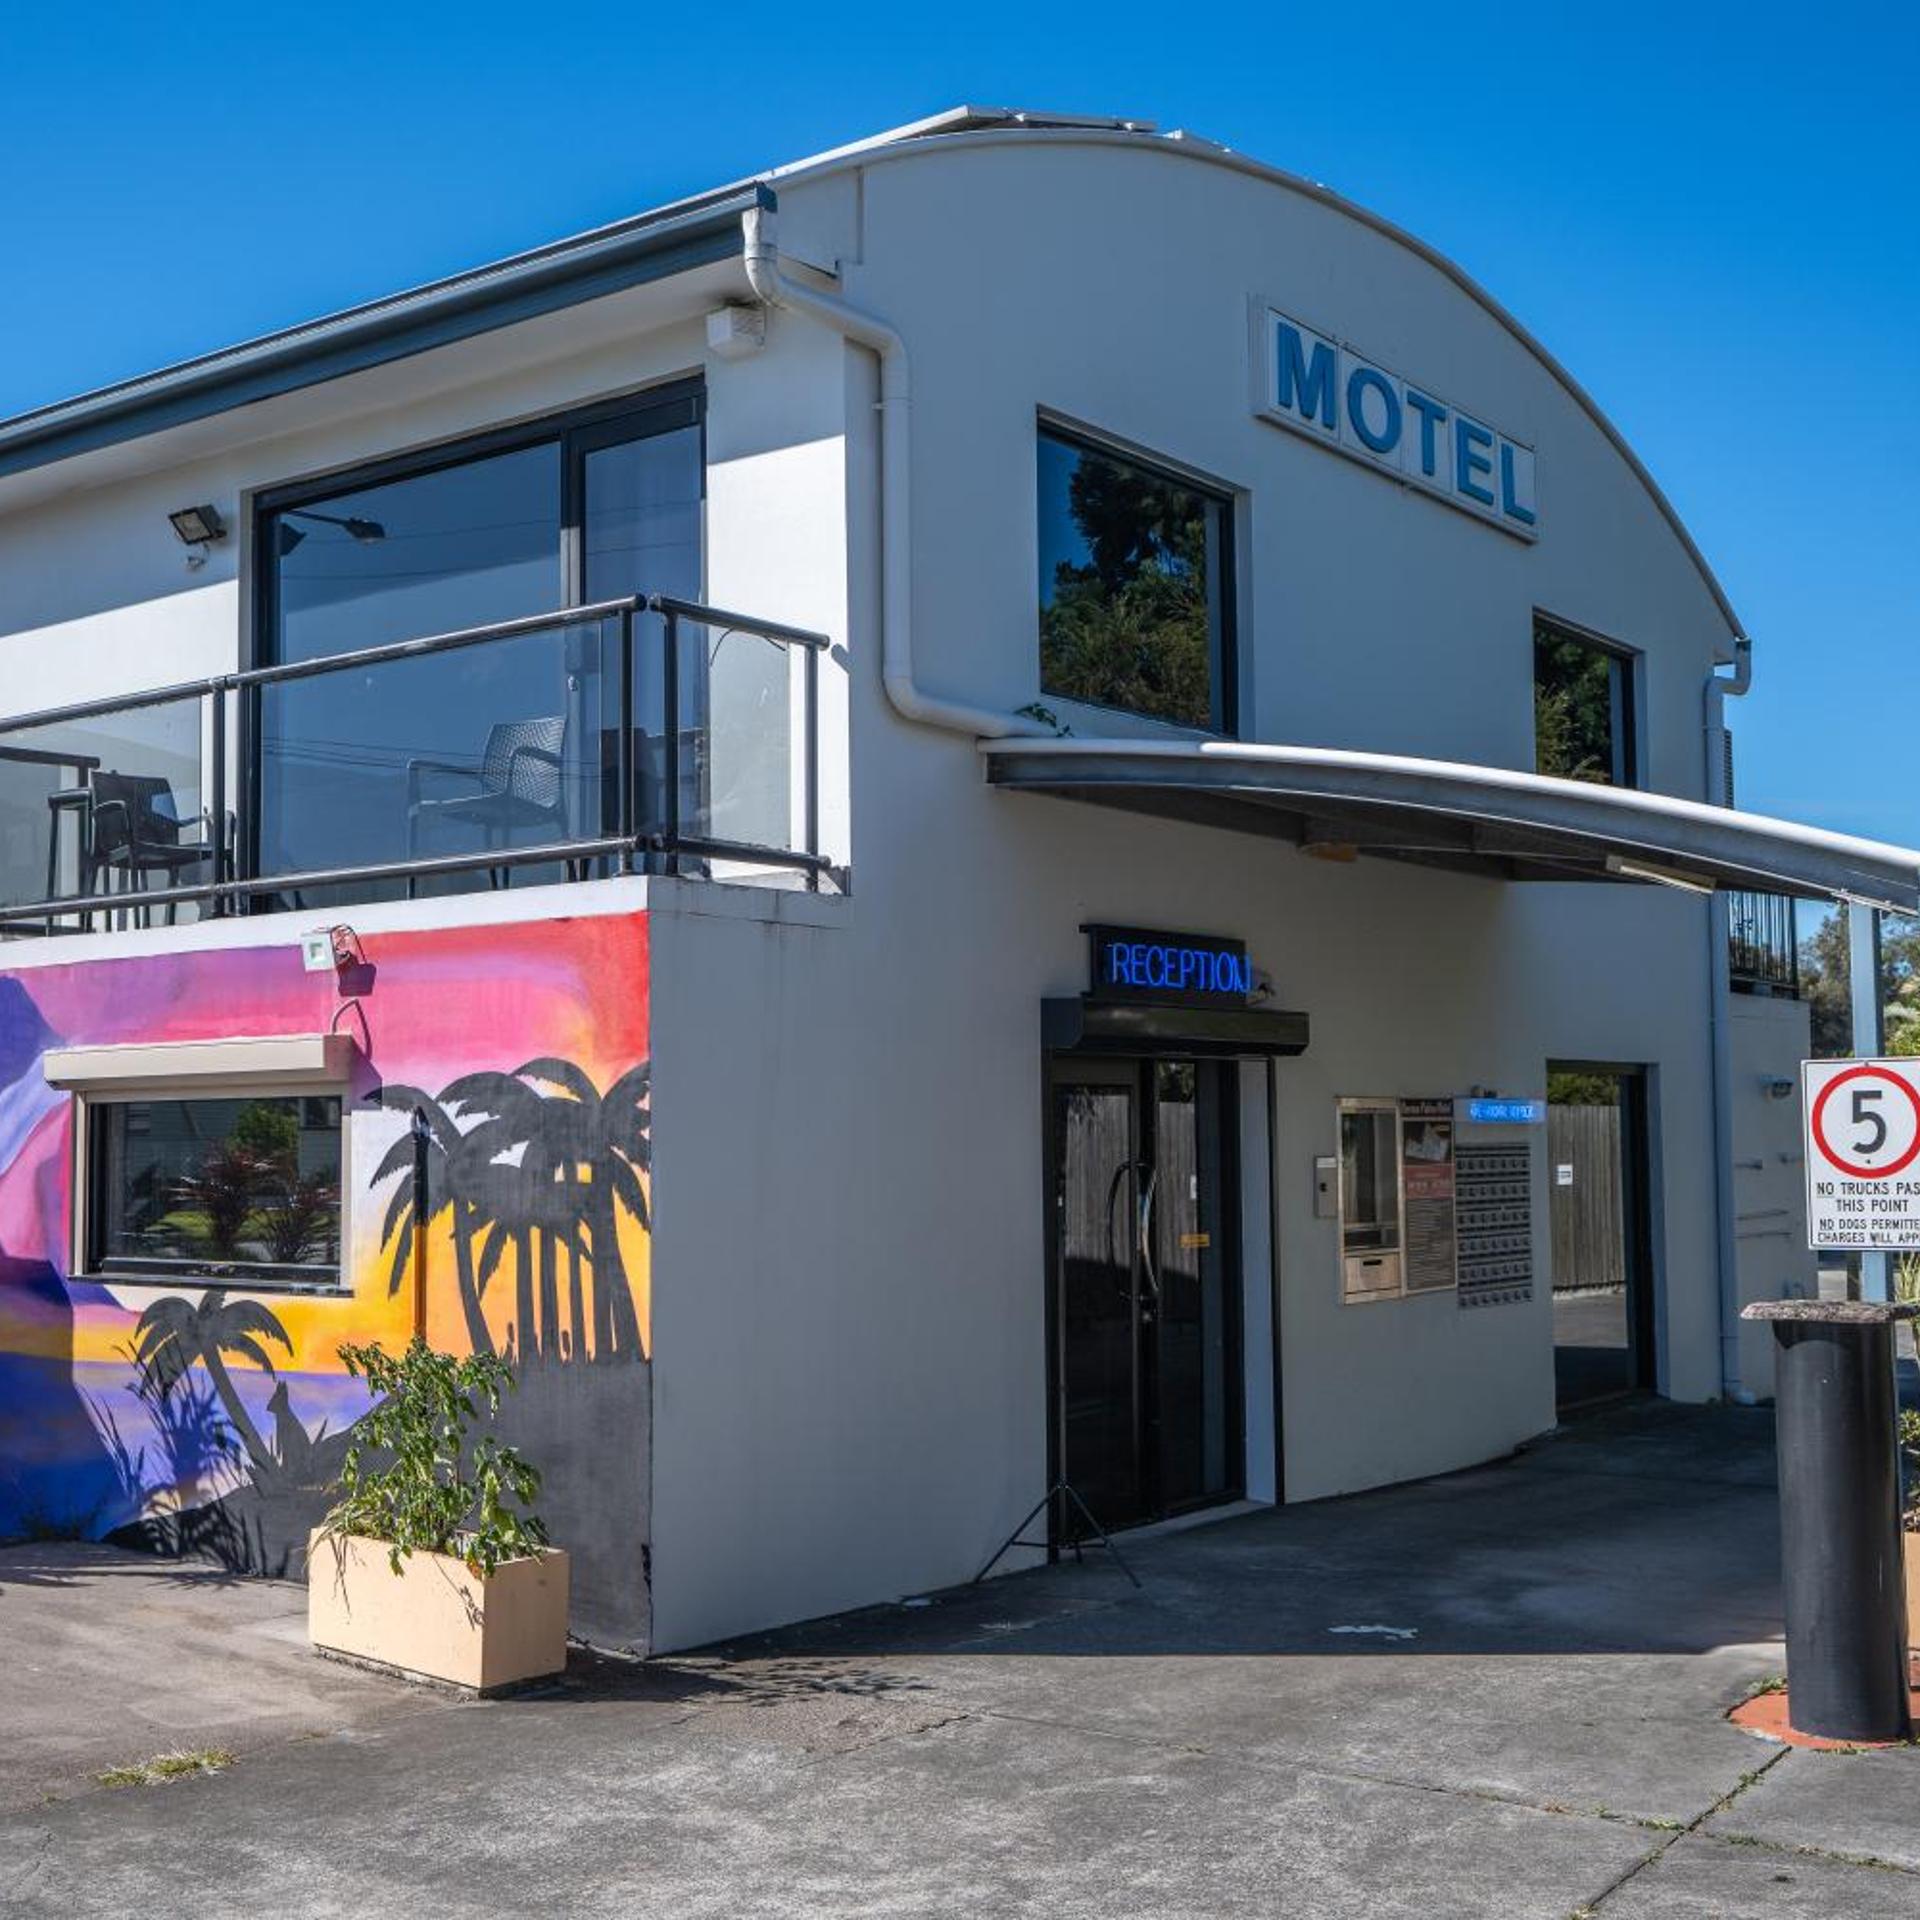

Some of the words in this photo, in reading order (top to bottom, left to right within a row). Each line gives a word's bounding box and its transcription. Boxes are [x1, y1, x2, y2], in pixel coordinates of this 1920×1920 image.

[1277, 322, 1536, 526] MOTEL
[1109, 942, 1253, 993] RECEPTION
[1852, 1090, 1887, 1155] 5
[1816, 1182, 1834, 1195] NO
[1841, 1182, 1889, 1195] TRUCKS
[1836, 1199, 1865, 1212] THIS
[1871, 1199, 1909, 1212] POINT
[1820, 1219, 1834, 1230] NO
[1839, 1219, 1867, 1230] DOGS
[1818, 1232, 1865, 1243] CHARGES
[1870, 1232, 1893, 1243] WILL
[1898, 1232, 1920, 1243] APP
